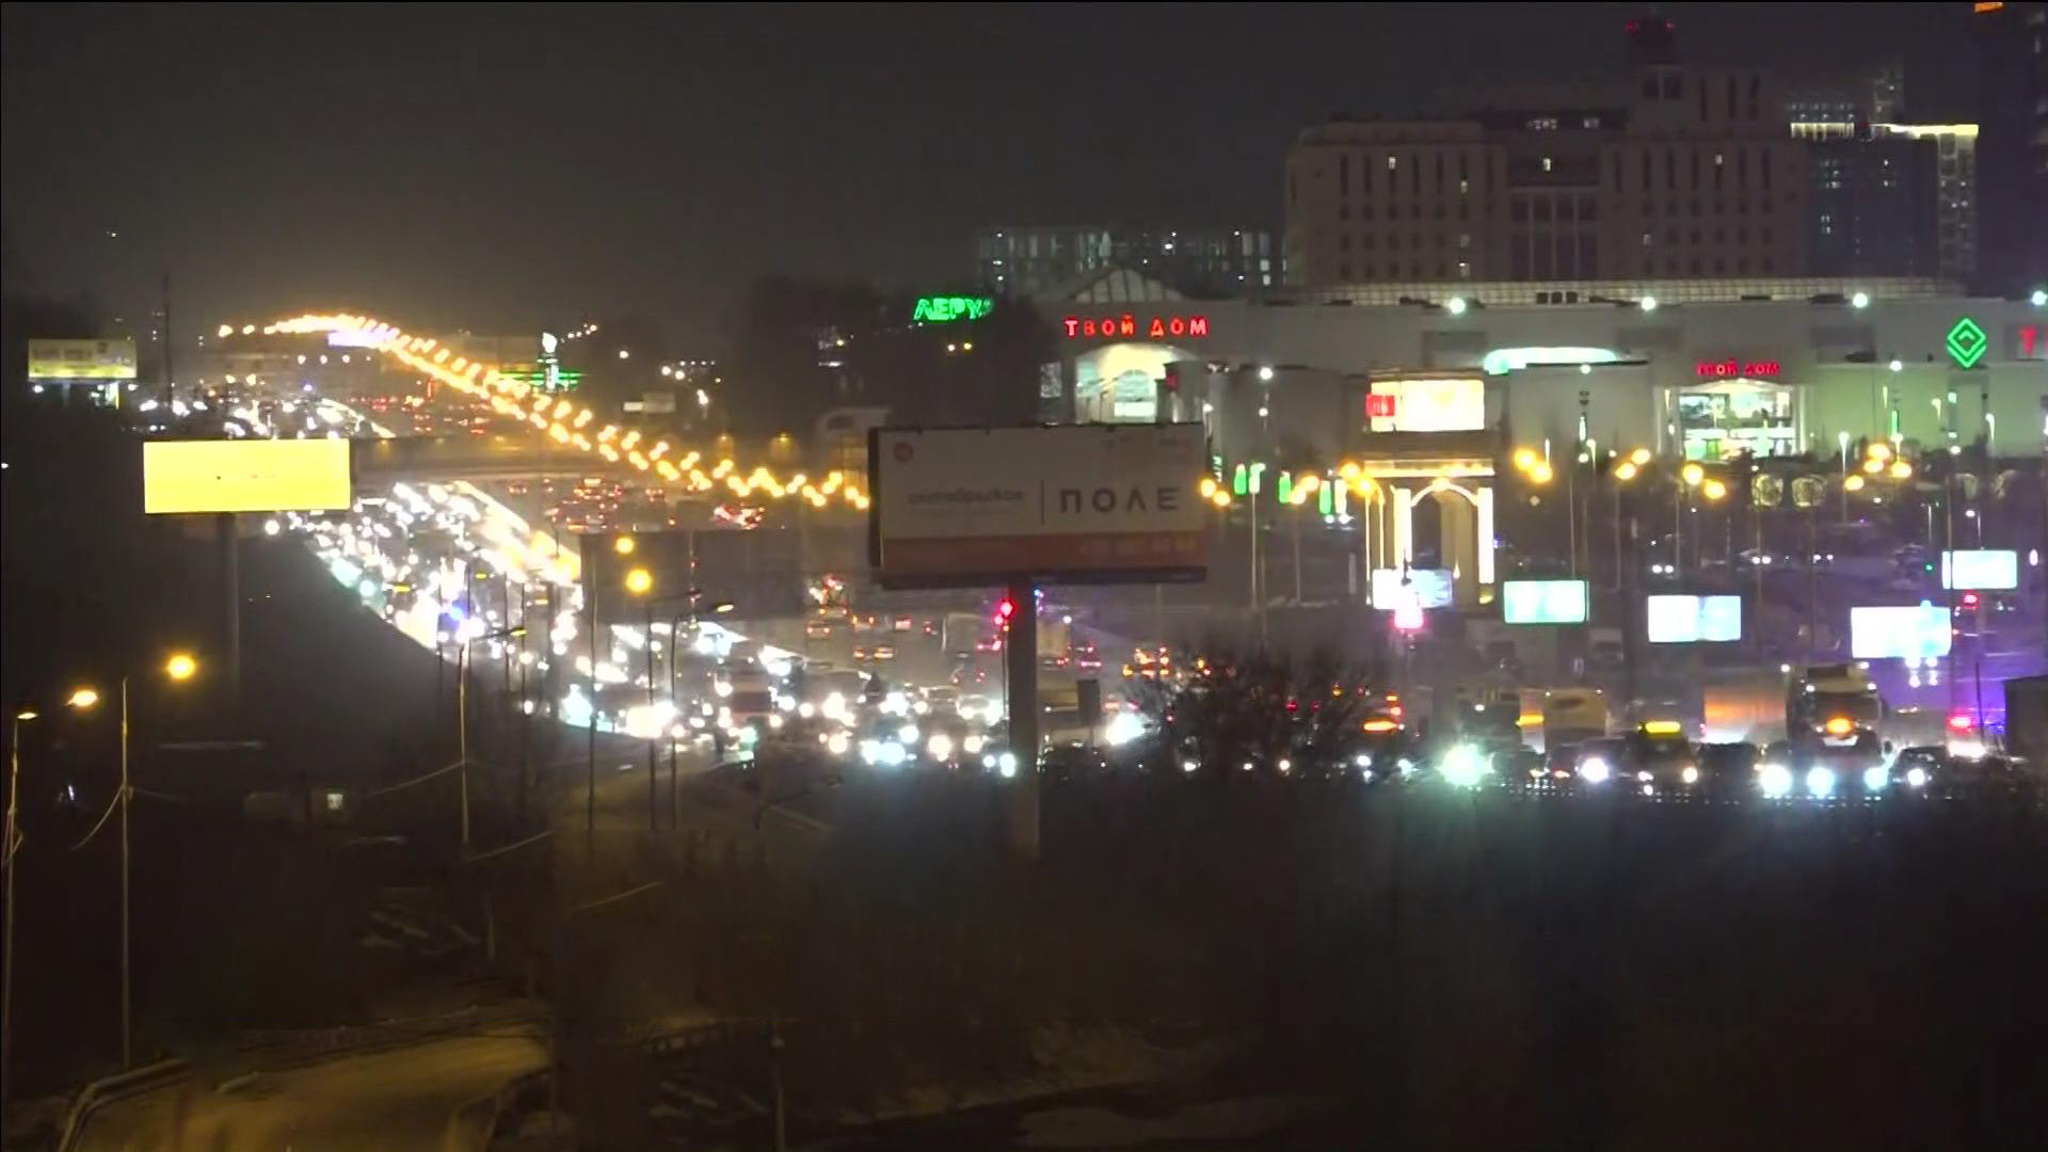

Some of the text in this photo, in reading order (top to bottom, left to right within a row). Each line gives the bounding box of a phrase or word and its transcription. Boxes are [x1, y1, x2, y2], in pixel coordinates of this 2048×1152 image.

[1064, 315, 1207, 336] ТВОЙ ДОМ
[1059, 486, 1179, 514] ПОЛЕ
